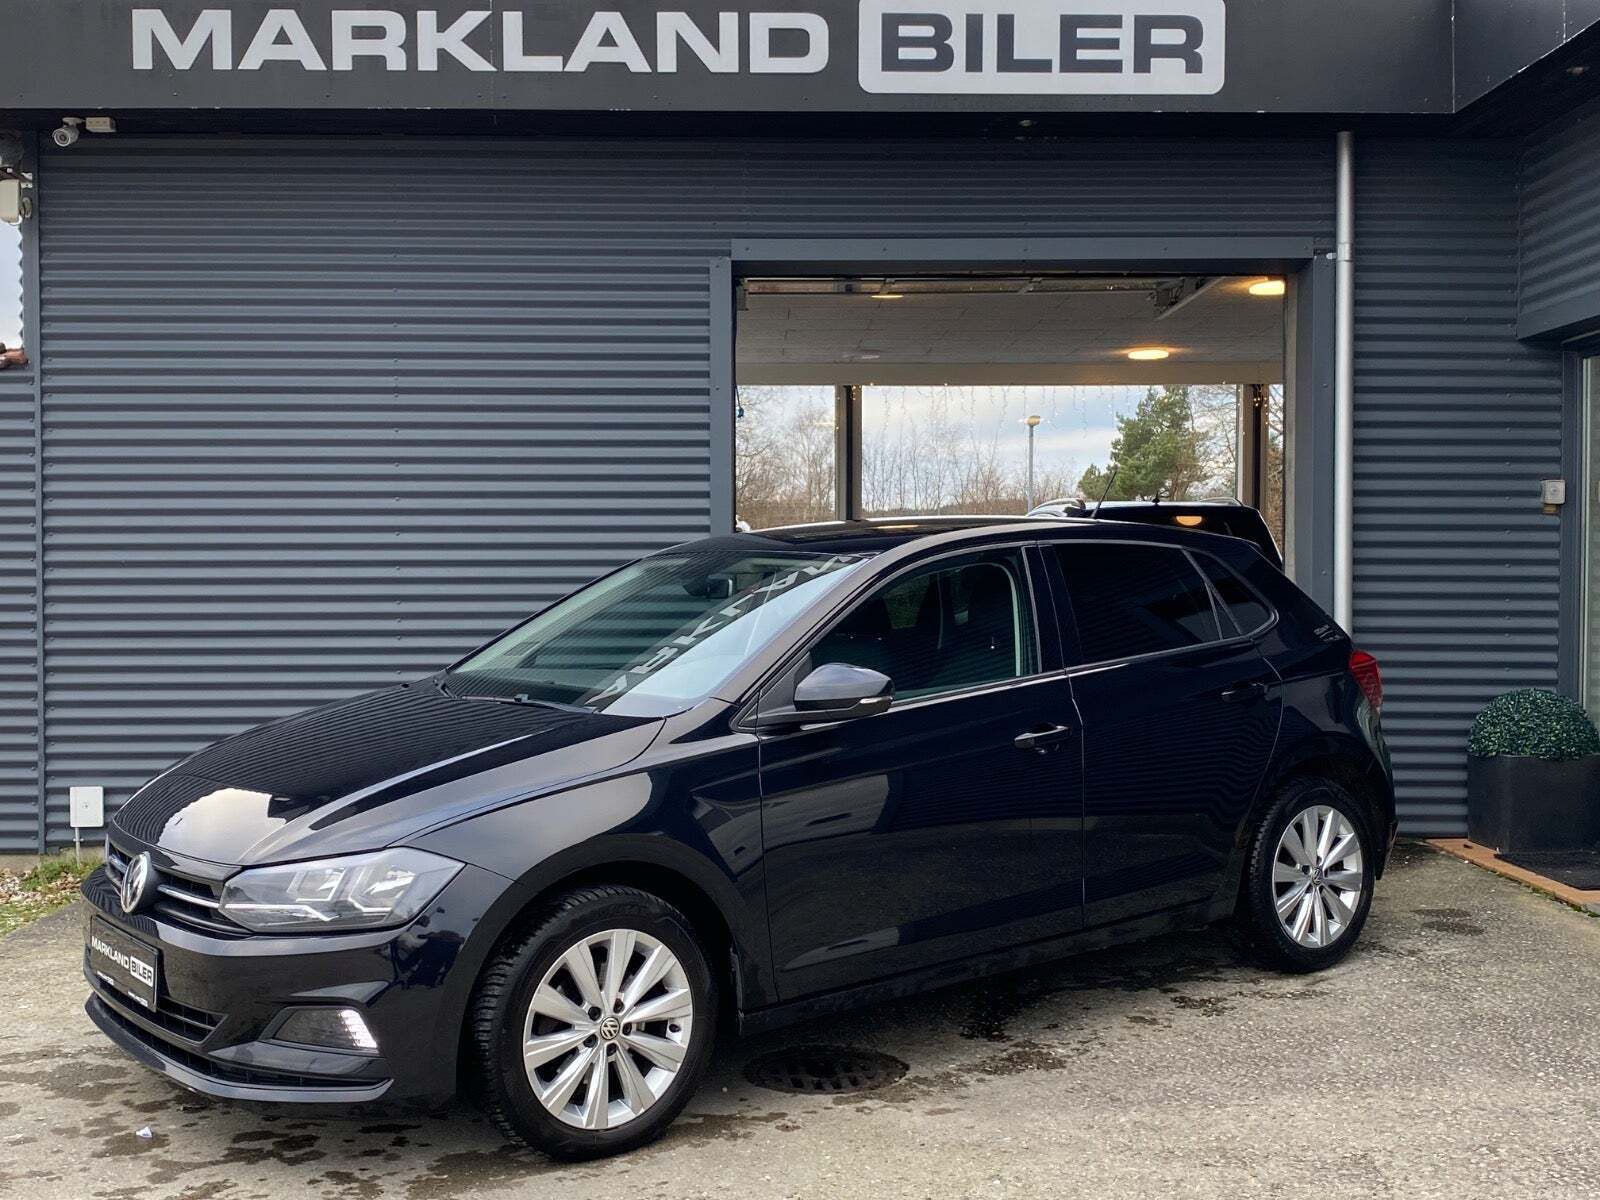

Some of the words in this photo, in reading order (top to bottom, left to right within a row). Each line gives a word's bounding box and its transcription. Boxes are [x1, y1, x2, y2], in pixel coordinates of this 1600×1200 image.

[131, 8, 829, 74] MARKLAND
[881, 13, 1204, 74] BILER
[91, 935, 130, 971] MARKLAND
[131, 957, 153, 983] BILER
